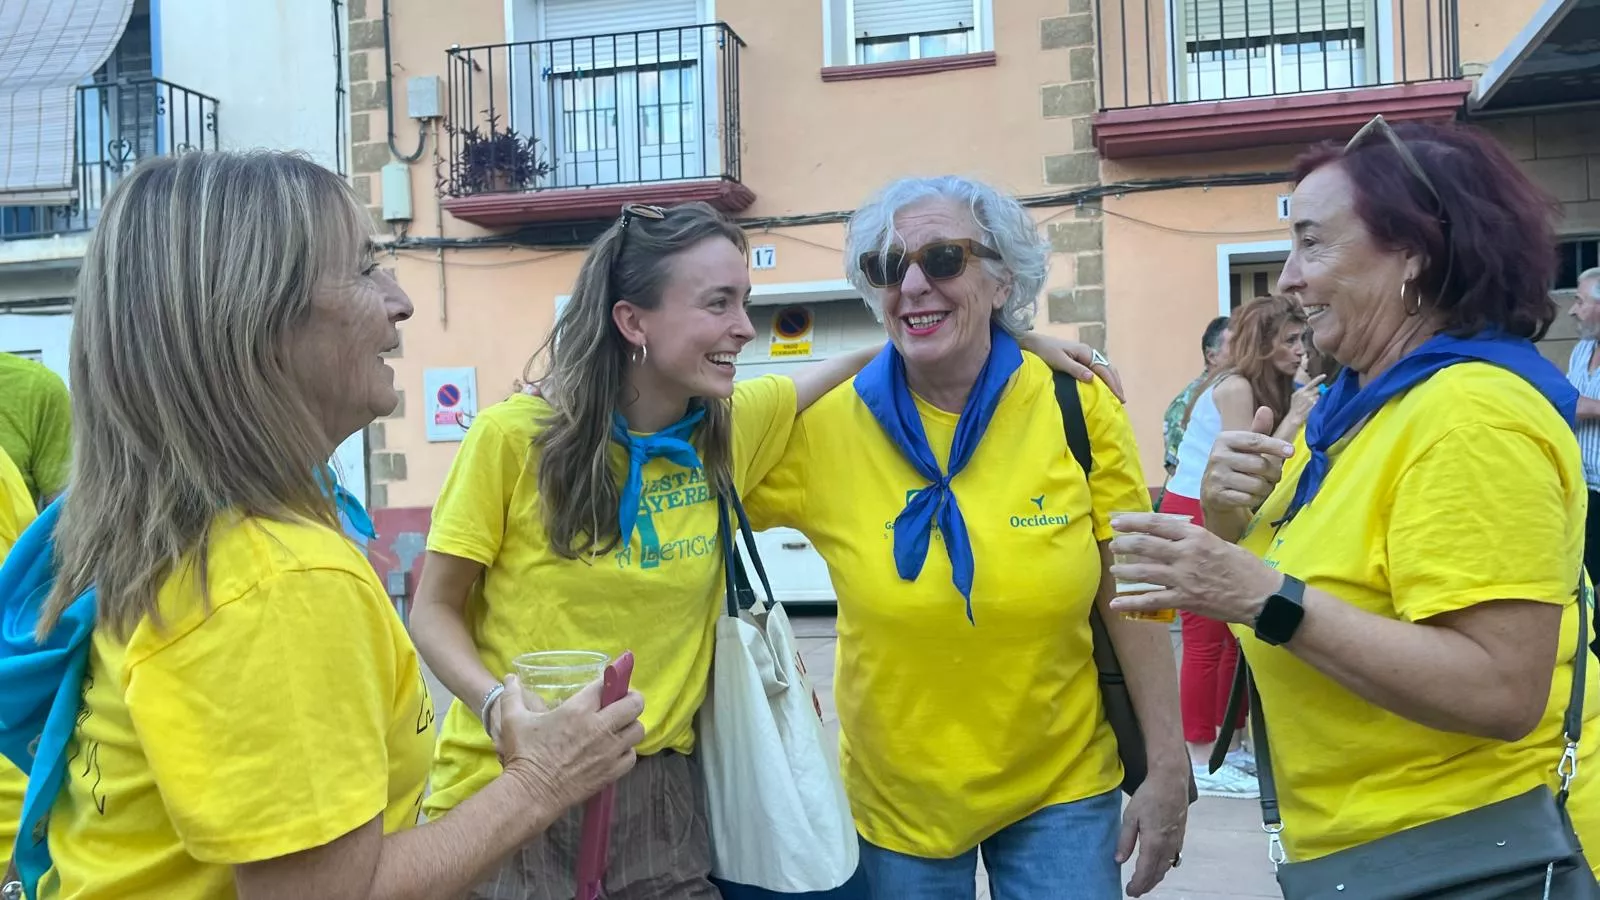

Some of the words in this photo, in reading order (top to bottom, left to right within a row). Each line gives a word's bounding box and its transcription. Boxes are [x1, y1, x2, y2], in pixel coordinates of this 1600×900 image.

[756, 249, 774, 266] 17
[638, 484, 716, 514] AYERB
[1009, 513, 1069, 528] Occident
